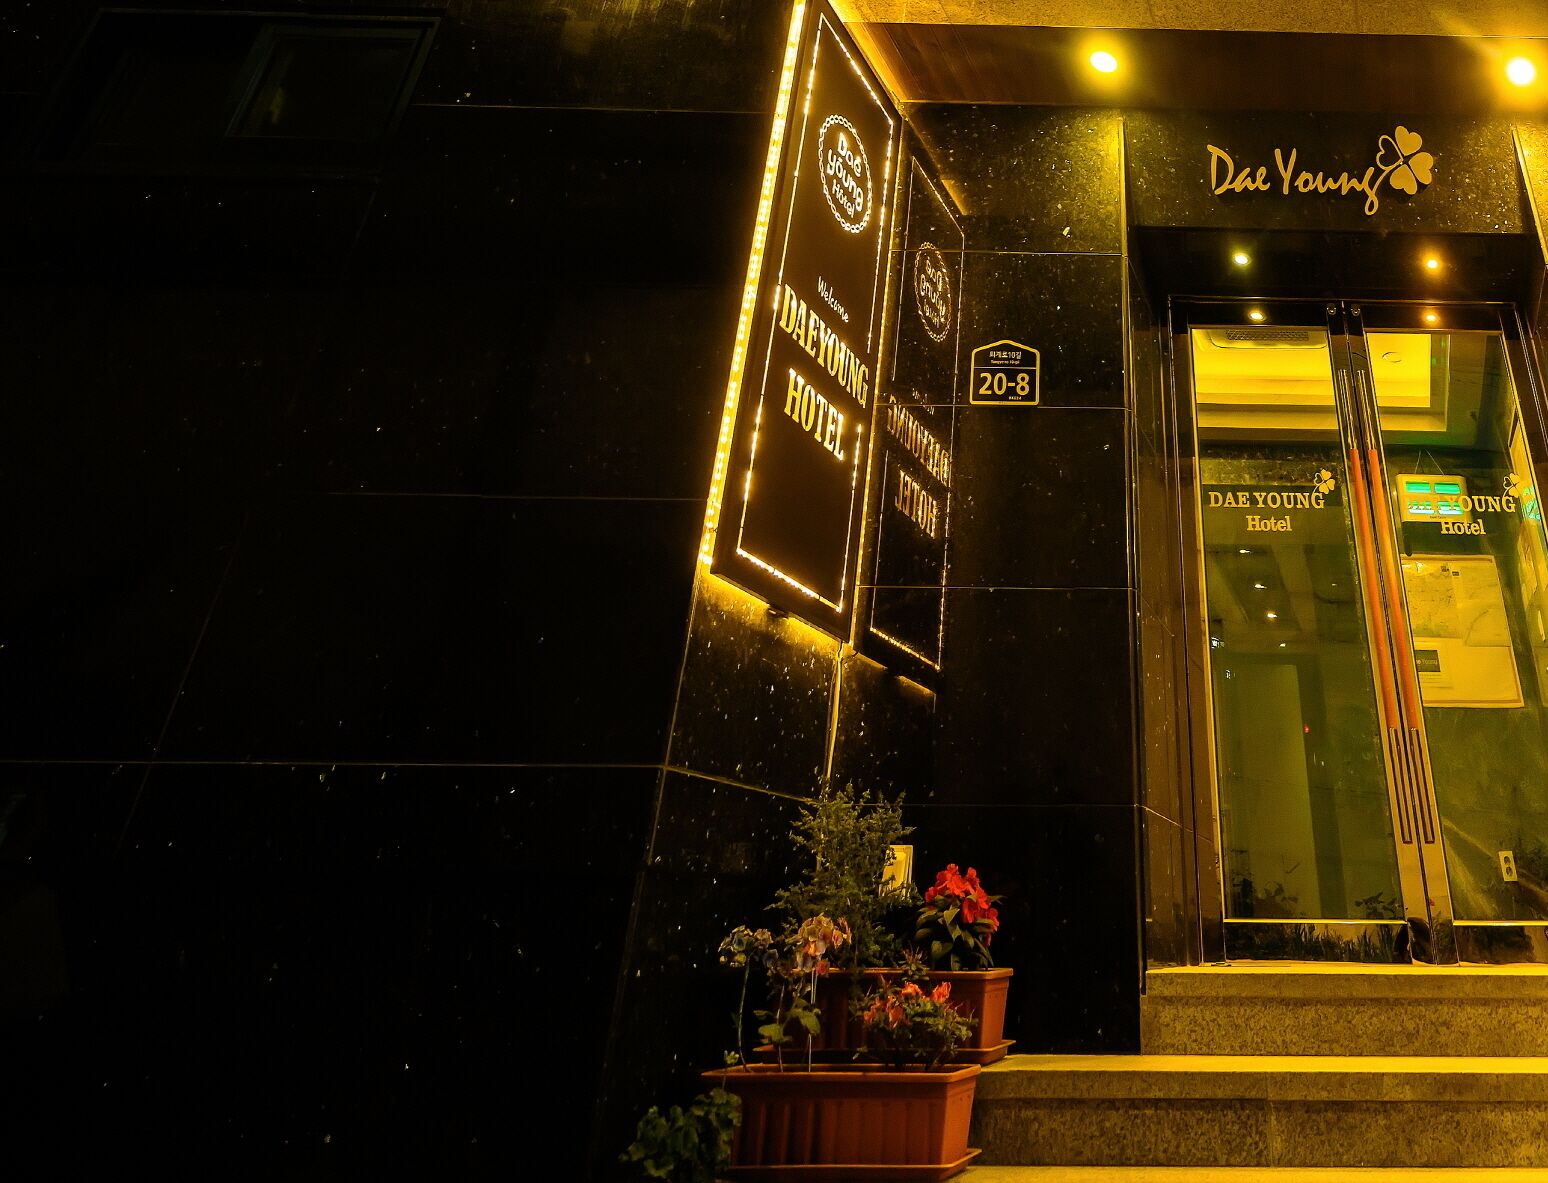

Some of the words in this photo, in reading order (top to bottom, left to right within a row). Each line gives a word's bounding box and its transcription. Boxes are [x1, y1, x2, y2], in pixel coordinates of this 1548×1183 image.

[838, 132, 862, 177] Dae
[832, 179, 855, 218] Hotel
[1207, 144, 1270, 195] Dae
[1274, 147, 1377, 216] Young
[817, 276, 849, 323] Welcome
[779, 283, 869, 408] DAEYOUNG
[979, 372, 1029, 395] 20-8
[784, 367, 844, 461] HOTEL
[1208, 491, 1250, 508] DAE
[1253, 492, 1325, 509] YOUNG
[1447, 495, 1516, 513] YOUNG
[1246, 515, 1292, 532] Hotel
[1440, 519, 1487, 535] Hotel
